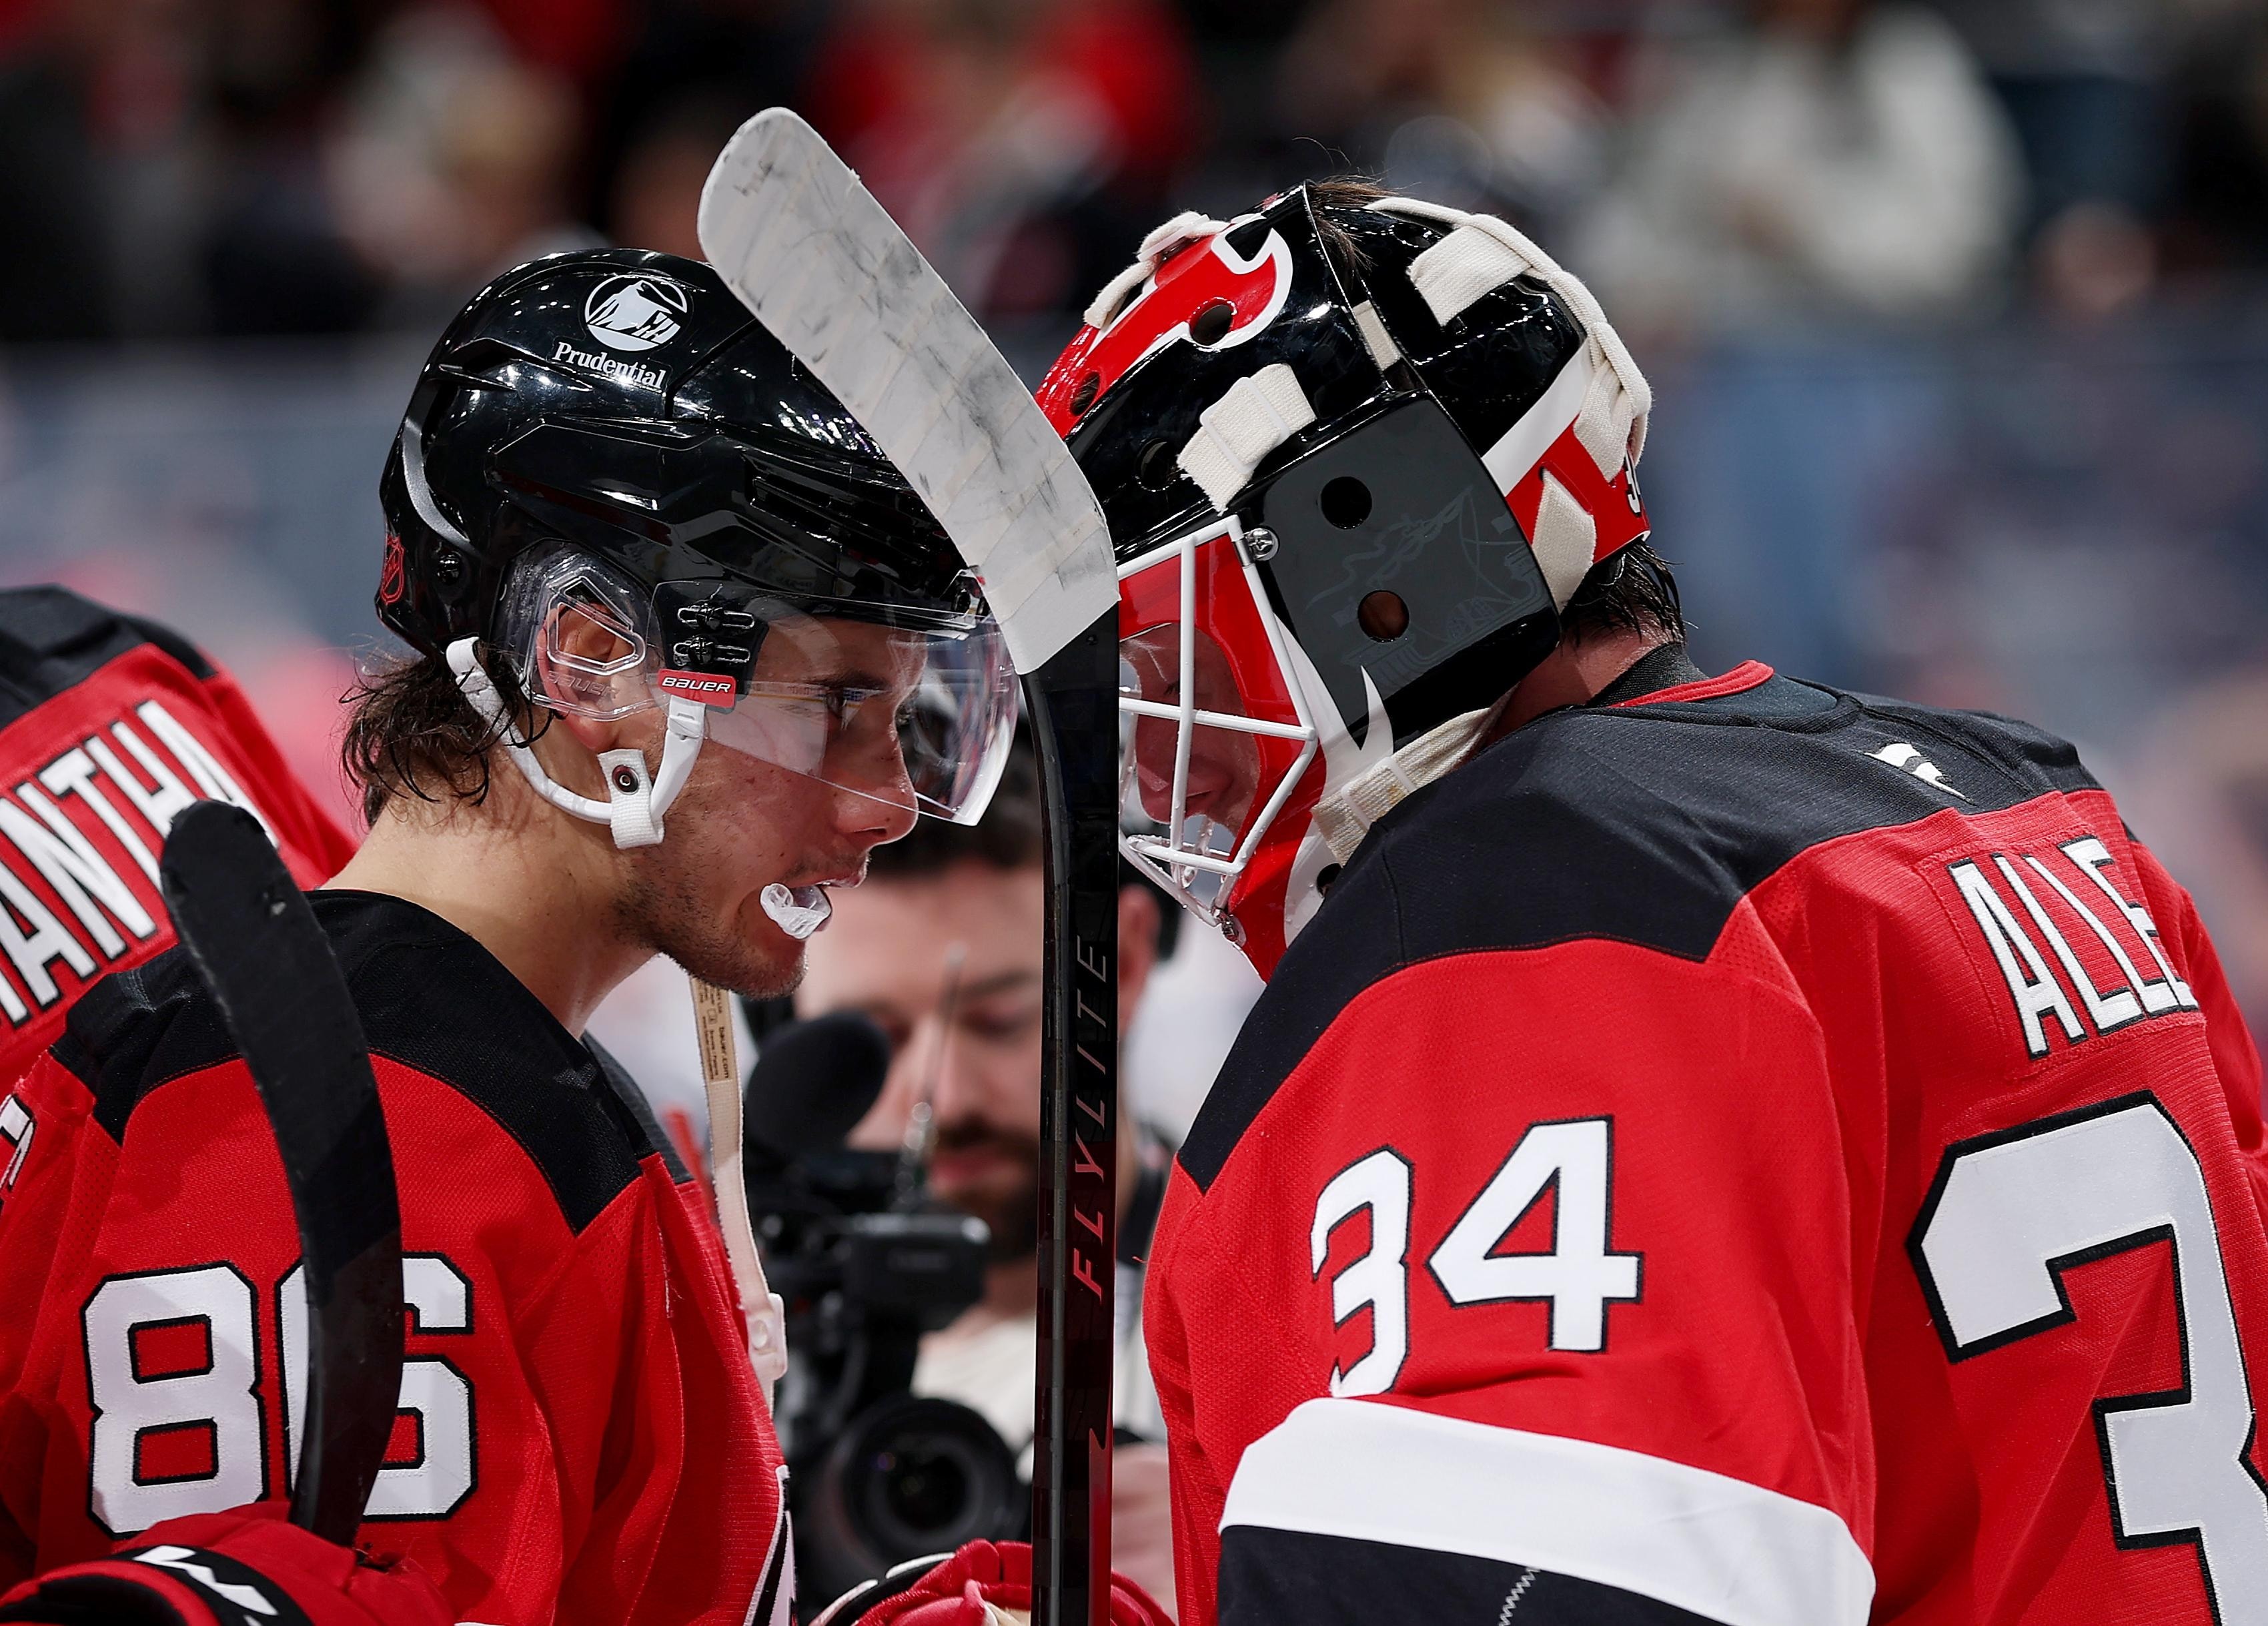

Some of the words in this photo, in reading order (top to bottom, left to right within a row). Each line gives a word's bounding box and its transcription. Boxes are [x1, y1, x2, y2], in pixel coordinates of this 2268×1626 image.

[551, 341, 666, 389] Prudential
[662, 677, 732, 693] BAUER
[1073, 935, 1107, 1302] FLYLITE
[1309, 1114, 1644, 1398] 34
[79, 1251, 478, 1541] 86
